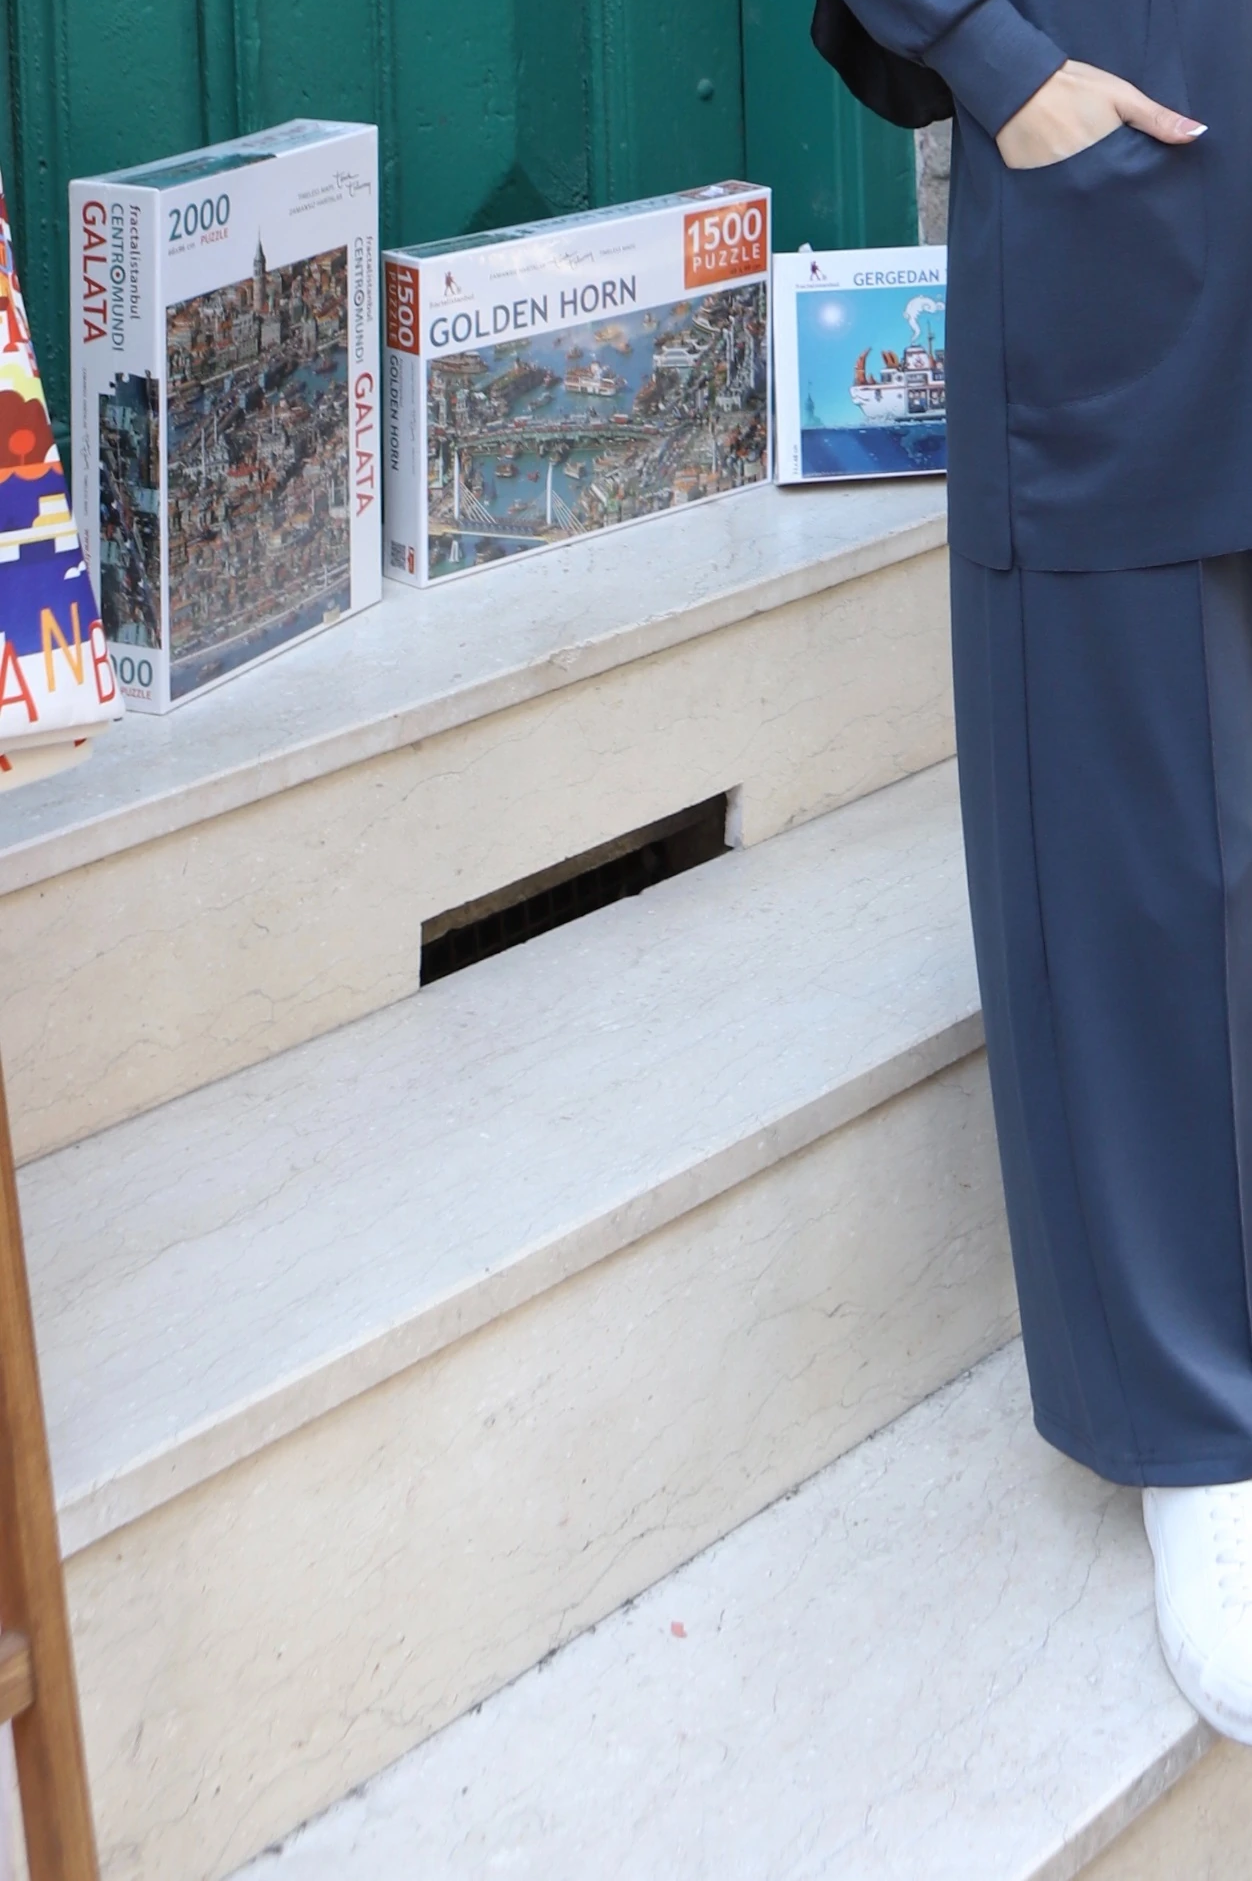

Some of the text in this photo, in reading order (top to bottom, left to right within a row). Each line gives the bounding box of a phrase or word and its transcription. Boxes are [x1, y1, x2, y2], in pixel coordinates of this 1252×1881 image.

[169, 193, 230, 242] 2000
[200, 227, 229, 246] PUZZLE
[688, 207, 762, 254] 1500
[82, 200, 107, 344] GALATA
[111, 202, 126, 352] CENTROMUNDI
[129, 204, 141, 320] fractalistanbul
[692, 243, 761, 274] PUZZLE
[853, 269, 940, 287] GERGEDAN
[388, 271, 398, 343] PUZZLE
[397, 270, 414, 348] 1500
[429, 274, 638, 348] GOLDEN HORN
[353, 236, 375, 517] CENTROMUNDI GALATA
[389, 354, 400, 472] GOLDEN HORN
